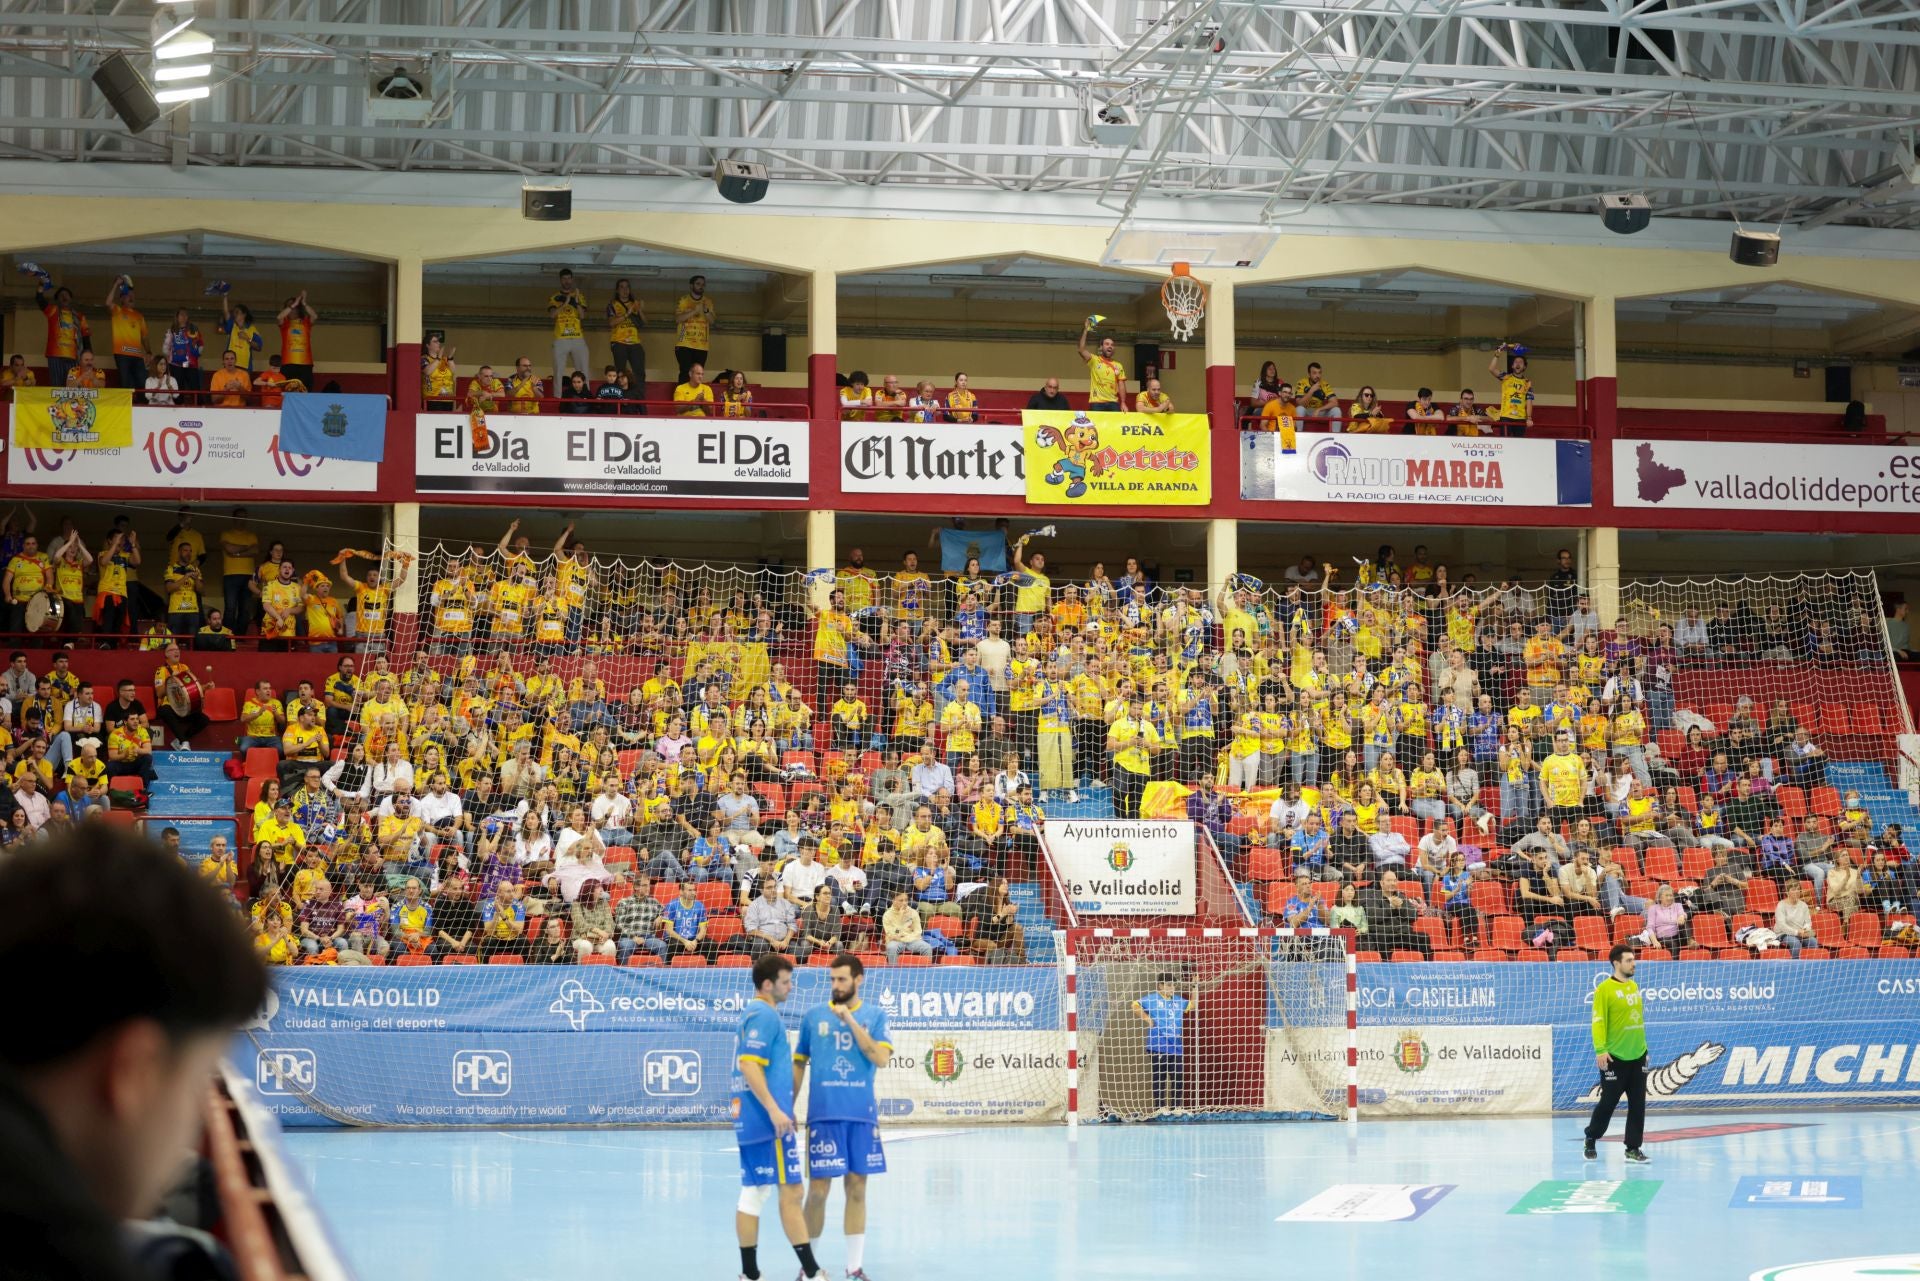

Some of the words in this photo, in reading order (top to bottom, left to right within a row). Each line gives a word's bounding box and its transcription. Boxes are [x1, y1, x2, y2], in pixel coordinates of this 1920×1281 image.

[1121, 422, 1164, 437] PEÑA
[208, 442, 239, 450] variedad
[434, 426, 463, 459] El
[472, 428, 530, 460] Día
[567, 428, 596, 462] El
[604, 431, 662, 464] Día
[698, 431, 726, 465] El
[734, 434, 791, 467] Día
[1451, 442, 1504, 450] VALLADOLID
[83, 446, 121, 456] musical
[208, 450, 246, 459] musical
[845, 435, 894, 480] El
[899, 434, 1004, 481] Norte
[1097, 446, 1199, 472] Petete
[472, 462, 484, 472] de
[485, 462, 530, 473] Valladolid
[604, 464, 616, 475] de
[617, 464, 662, 476] Valladolid
[734, 467, 746, 478] de
[748, 468, 792, 478] Valladolid
[564, 482, 668, 493] www.eldiadevalladolid.com
[1090, 480, 1126, 492] VILLA
[1128, 481, 1144, 492] DE
[1147, 482, 1199, 492] ARANDA
[1328, 492, 1344, 500] LA
[1347, 492, 1386, 501] RADIO
[1388, 494, 1416, 502] QUE
[1418, 494, 1452, 502] HACE
[1456, 494, 1504, 504] AFICIÓN
[180, 786, 212, 794] Recoletas
[1064, 823, 1178, 842] Ayuntamiento
[1088, 880, 1182, 896] Valladolid
[290, 988, 441, 1008] VALLADOLID
[1355, 987, 1396, 1008] ASCA
[1406, 988, 1496, 1008] CASTELLANA
[1640, 982, 1723, 1000] recoletas
[1730, 982, 1776, 1000] salud
[612, 992, 706, 1011] recoletas
[714, 992, 752, 1011] salu
[900, 992, 1034, 1018] navarro
[285, 1017, 326, 1029] ciudad
[331, 1018, 370, 1031] amiga
[373, 1018, 392, 1029] del
[396, 1018, 446, 1031] deporte
[929, 1020, 964, 1028] térmicas
[832, 1030, 853, 1051] 19
[1438, 1046, 1458, 1060] de
[1464, 1044, 1542, 1060] Valladolid
[973, 1054, 995, 1068] de
[260, 1054, 312, 1090] PPG
[456, 1055, 508, 1090] PPG
[647, 1056, 698, 1091] PPG
[396, 1104, 414, 1114] We
[416, 1104, 452, 1118] protect
[454, 1104, 474, 1115] and
[476, 1104, 518, 1118] beautify
[520, 1104, 536, 1115] the
[588, 1104, 605, 1115] We
[607, 1104, 644, 1118] protect
[646, 1104, 666, 1115] and
[667, 1104, 708, 1118] beautify
[710, 1104, 726, 1115] the
[924, 1100, 982, 1108] Fundación
[986, 1100, 1046, 1108] Municipal
[810, 1158, 846, 1168] UEMC
